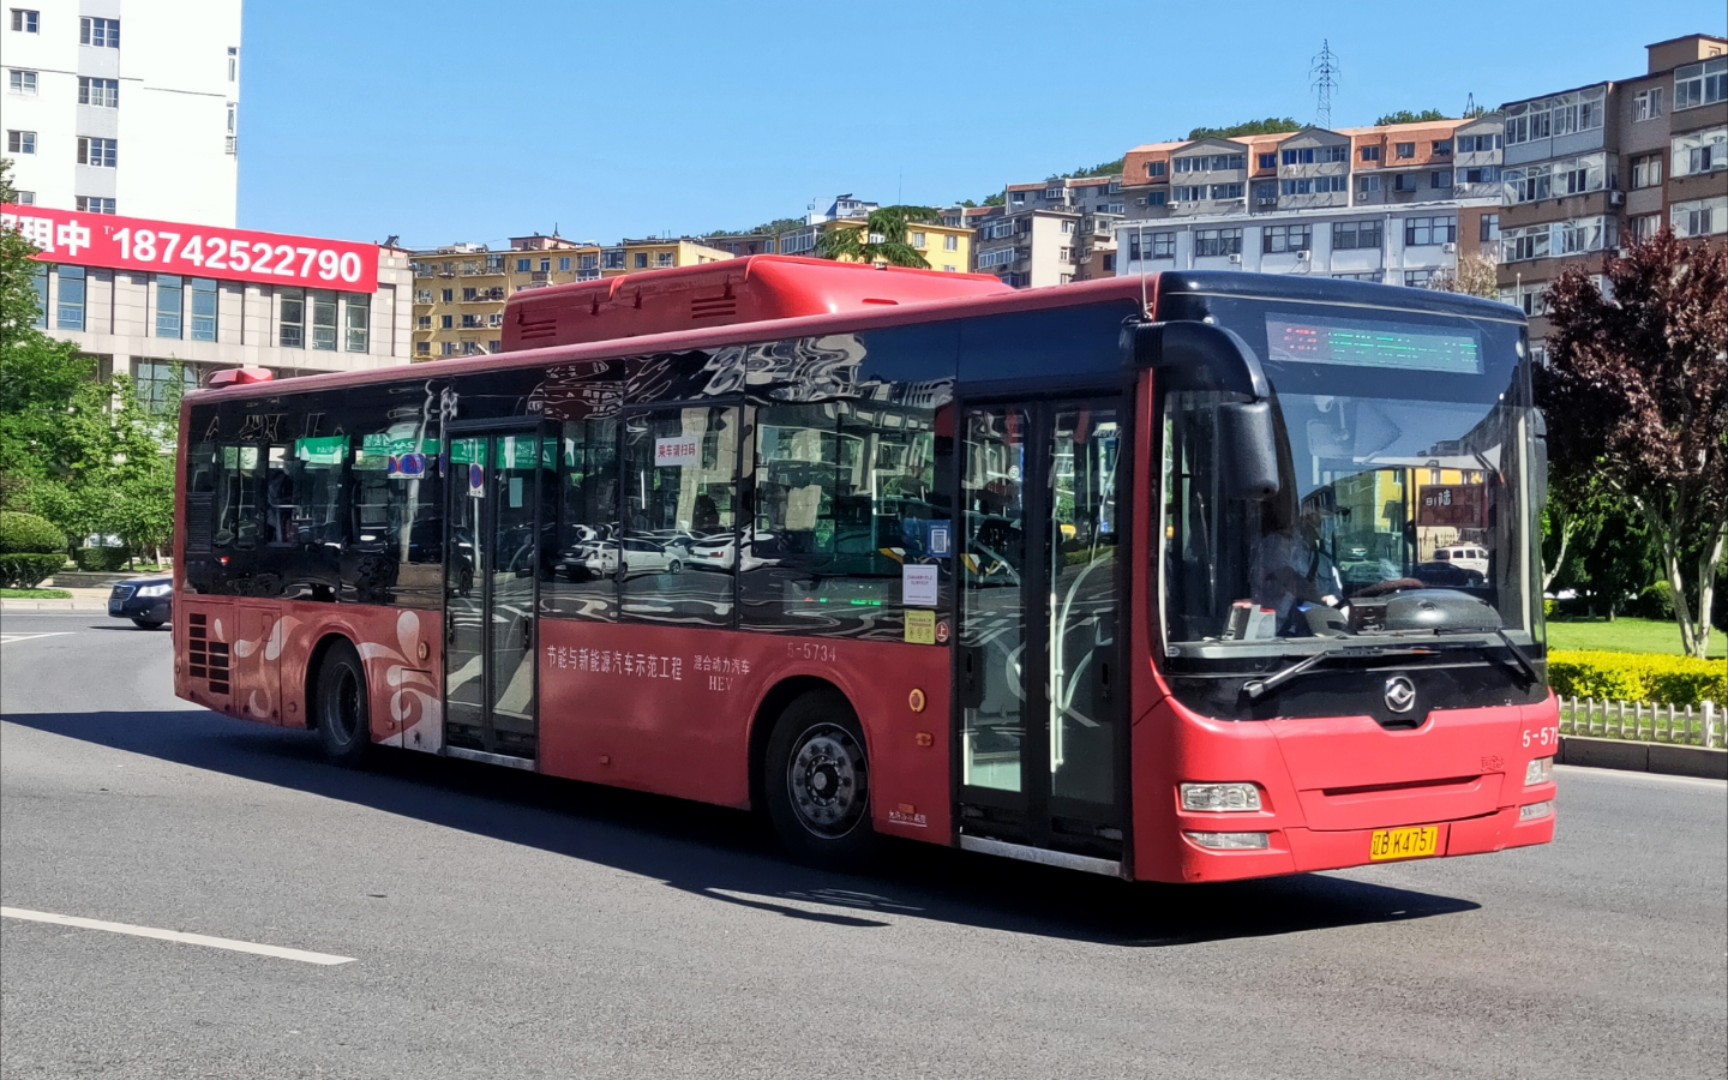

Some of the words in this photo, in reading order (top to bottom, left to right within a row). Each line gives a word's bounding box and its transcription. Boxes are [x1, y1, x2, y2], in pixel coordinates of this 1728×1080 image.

[112, 227, 362, 283] 18742522790
[787, 642, 836, 661] 5-5734
[547, 645, 682, 680] 节能与新能源汽车示范工程
[693, 655, 750, 674] 混合动力汽车
[708, 675, 734, 691] HEV
